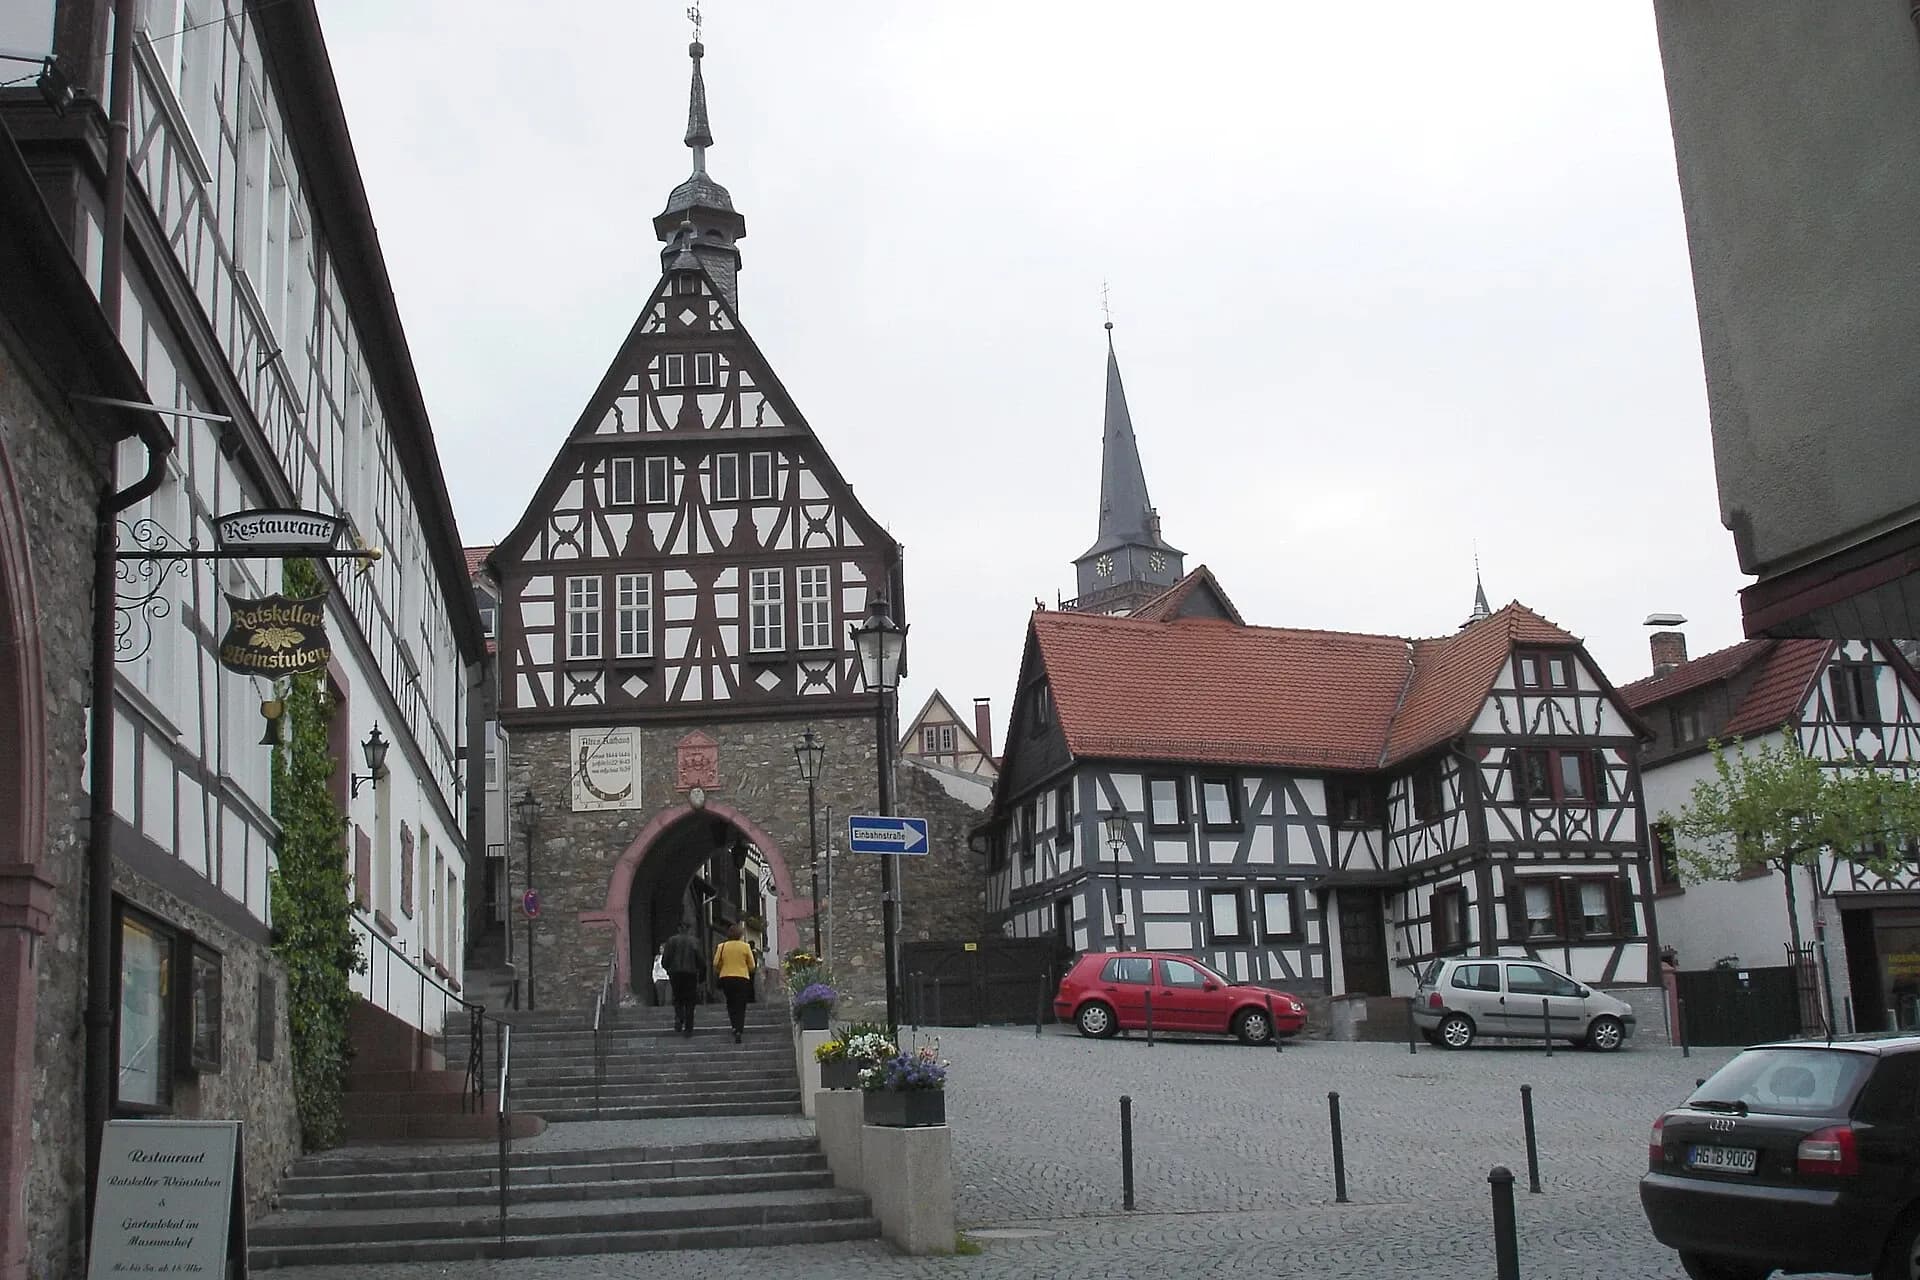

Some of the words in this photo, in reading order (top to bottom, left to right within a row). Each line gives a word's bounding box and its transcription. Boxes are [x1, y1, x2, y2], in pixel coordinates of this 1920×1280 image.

[232, 603, 320, 629] Ratskeller
[223, 645, 329, 669] Weinstuben
[855, 829, 905, 840] Einbahnstraße
[128, 1149, 205, 1164] Restaurant
[1695, 1146, 1709, 1164] HG
[1716, 1149, 1724, 1165] B
[1726, 1149, 1756, 1169] 9009
[107, 1175, 159, 1188] Ratskeller
[163, 1175, 221, 1188] Weinstuben
[122, 1217, 183, 1230] Gartenlokal
[185, 1219, 199, 1229] im
[127, 1236, 194, 1248] Museumshof
